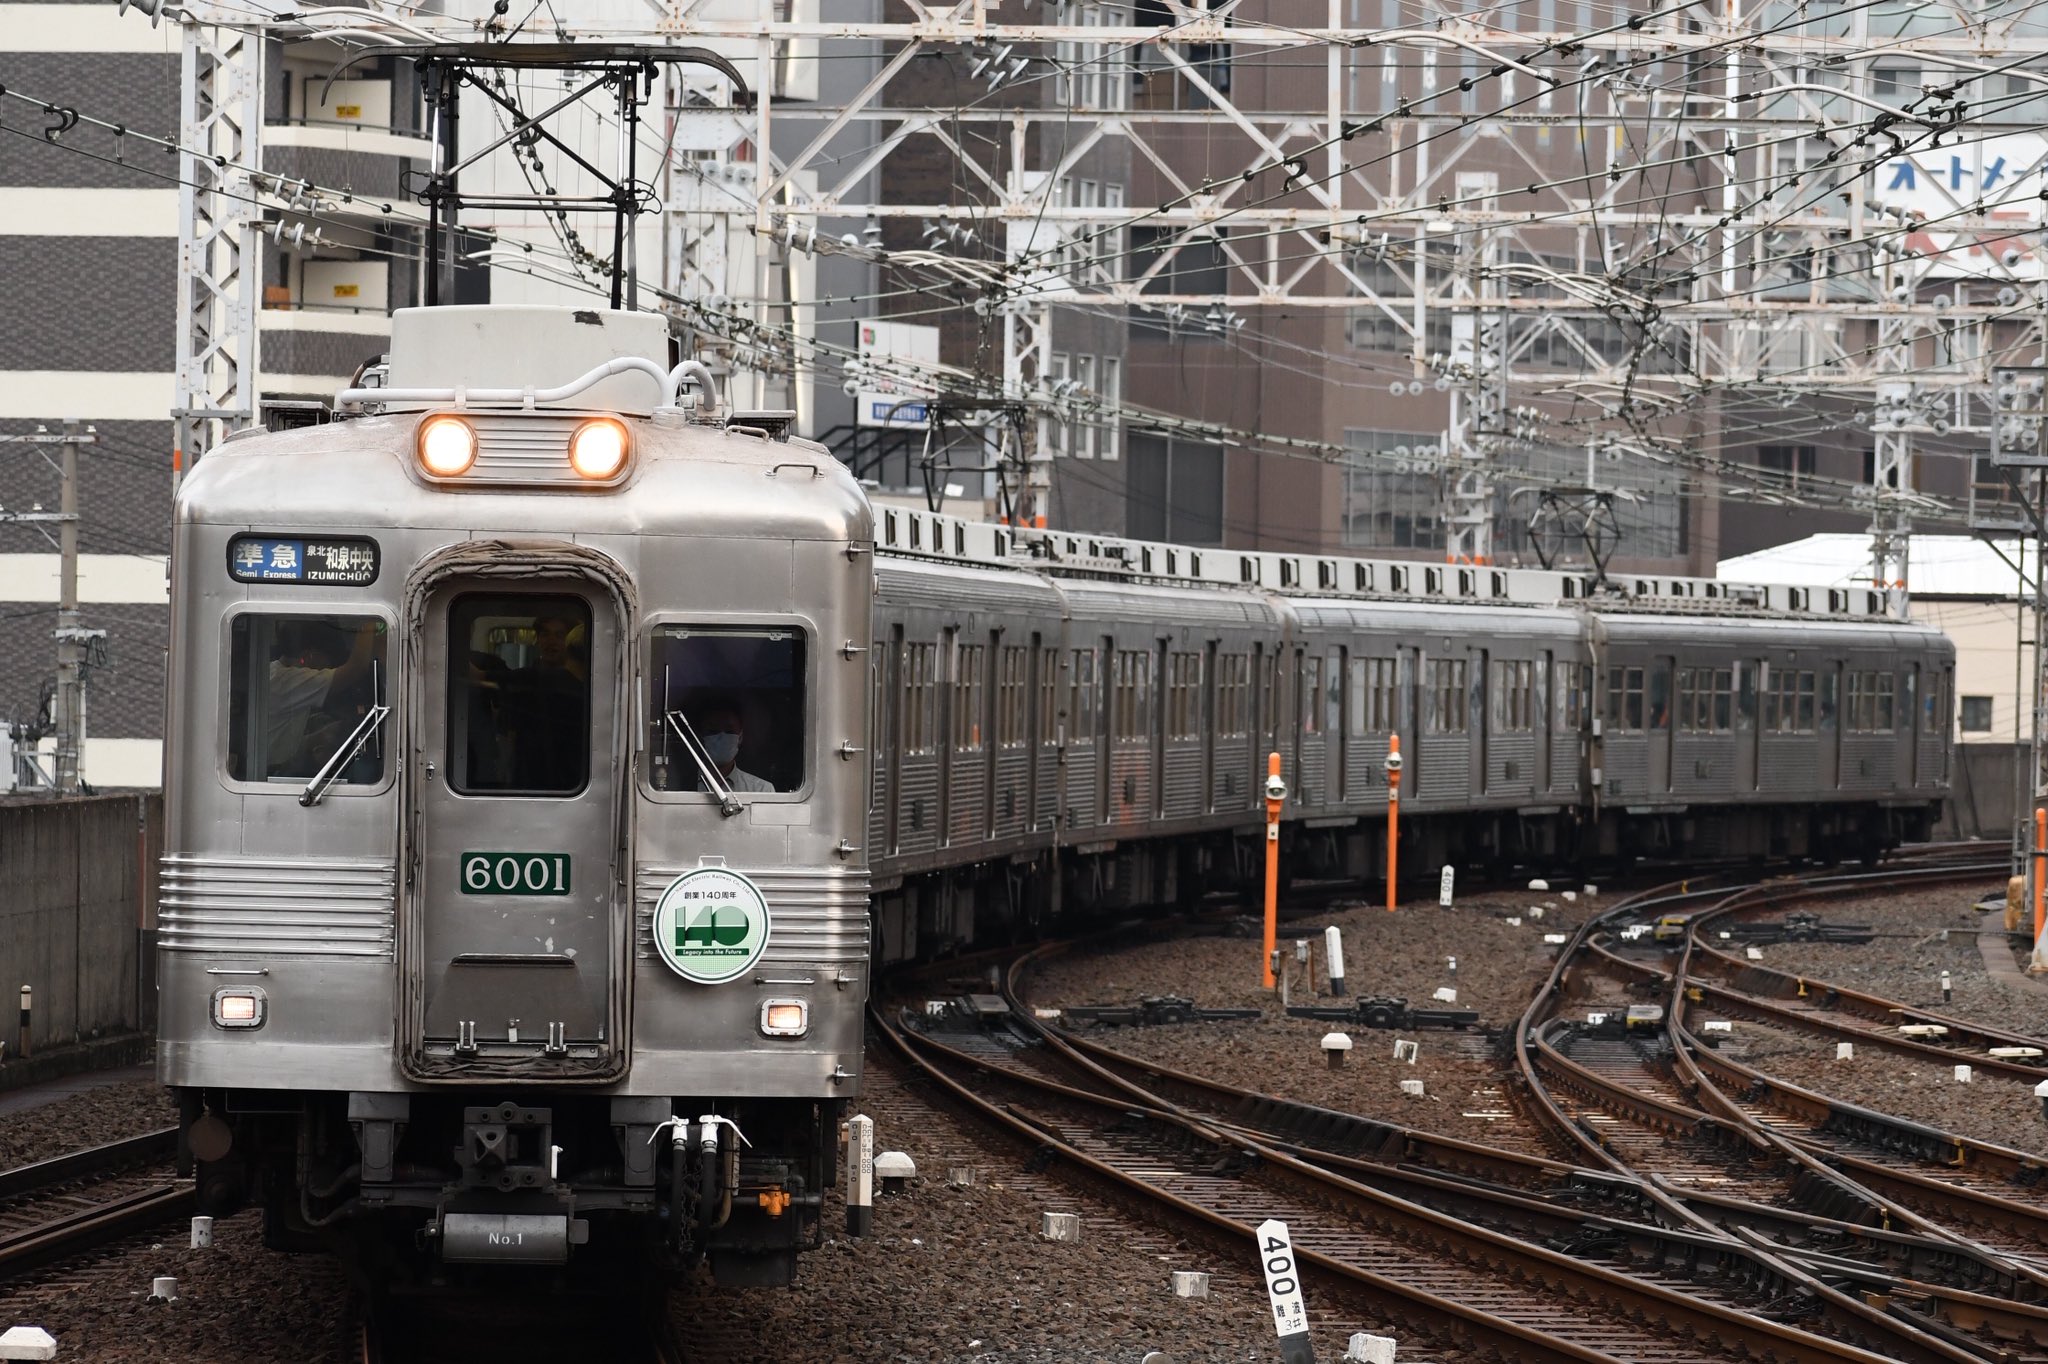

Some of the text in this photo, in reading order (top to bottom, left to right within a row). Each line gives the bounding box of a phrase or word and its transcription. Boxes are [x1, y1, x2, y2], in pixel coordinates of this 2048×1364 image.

[1888, 155, 2048, 190] オートメー
[237, 543, 297, 569] 準急
[236, 569, 257, 578] Semi
[263, 570, 297, 579] Express
[466, 857, 565, 890] 6001
[675, 880, 691, 892] Nankai
[692, 874, 710, 882] Electric
[712, 874, 732, 882] Railway
[684, 891, 737, 900] 創業140周年
[675, 906, 749, 946] 140
[683, 949, 702, 957] Legacy
[489, 1232, 522, 1245] No.1
[1264, 1236, 1295, 1295] 400
